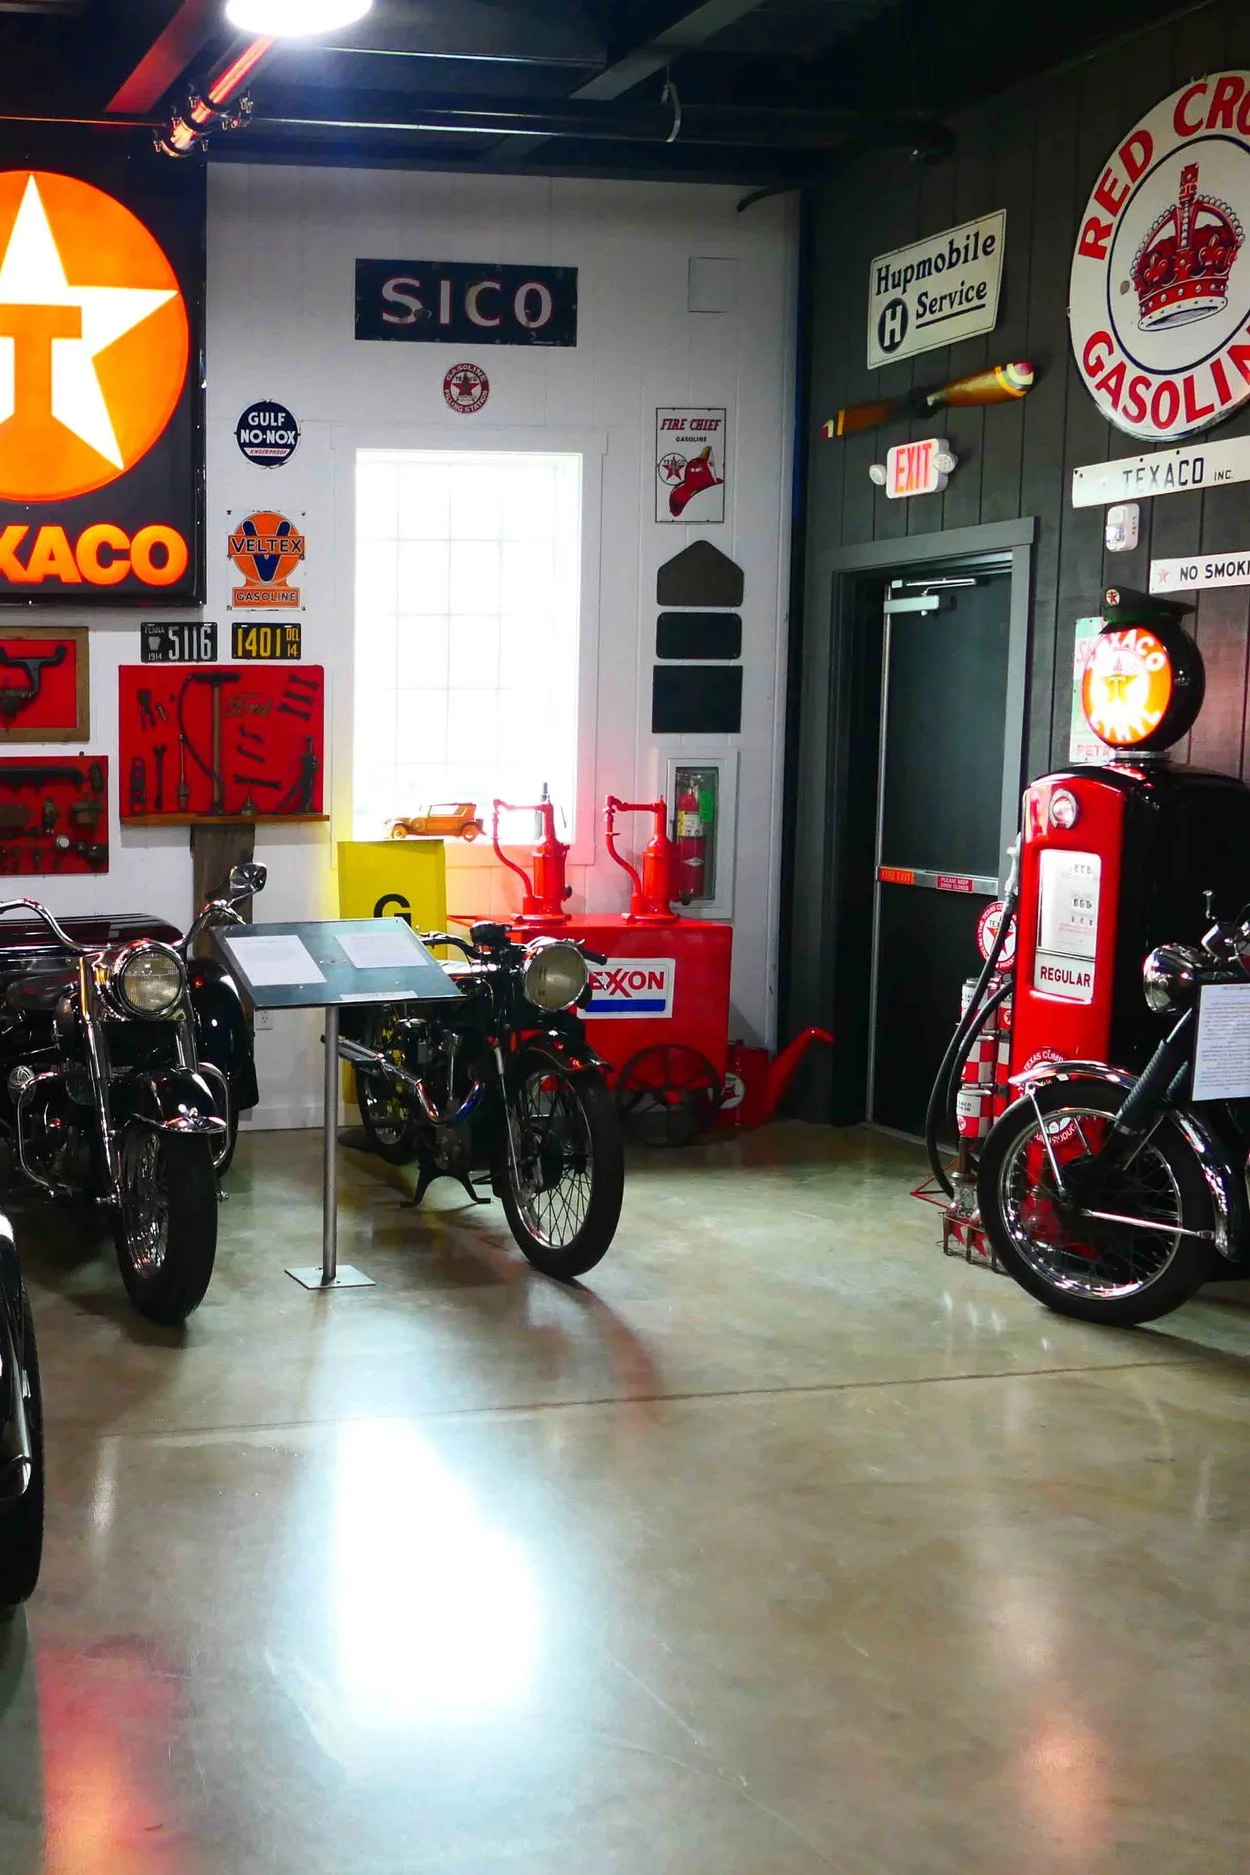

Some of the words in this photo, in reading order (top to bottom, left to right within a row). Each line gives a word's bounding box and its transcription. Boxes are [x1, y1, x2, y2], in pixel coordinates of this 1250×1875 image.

[1078, 129, 1154, 260] RED
[875, 230, 996, 296] Hupmobile
[381, 277, 553, 328] SICO
[916, 280, 987, 320] Service
[884, 305, 903, 347] H
[1083, 325, 1250, 430] GASOLIN
[248, 412, 286, 426] GULF
[660, 418, 687, 430] FIRE
[690, 418, 721, 431] CHIEF
[895, 443, 932, 493] EXIT
[1123, 457, 1204, 493] TEXACO
[1214, 469, 1233, 481] INC.
[231, 538, 301, 552] VELTEX
[1180, 565, 1198, 581] NO
[1205, 559, 1250, 579] SMOKI
[236, 592, 296, 602] GASOLINE
[168, 626, 212, 660] 5116
[237, 627, 282, 658] 1401
[286, 627, 300, 641] DEL
[287, 644, 298, 657] 14
[588, 968, 664, 997] EXXON
[1040, 966, 1091, 987] REGULAR
